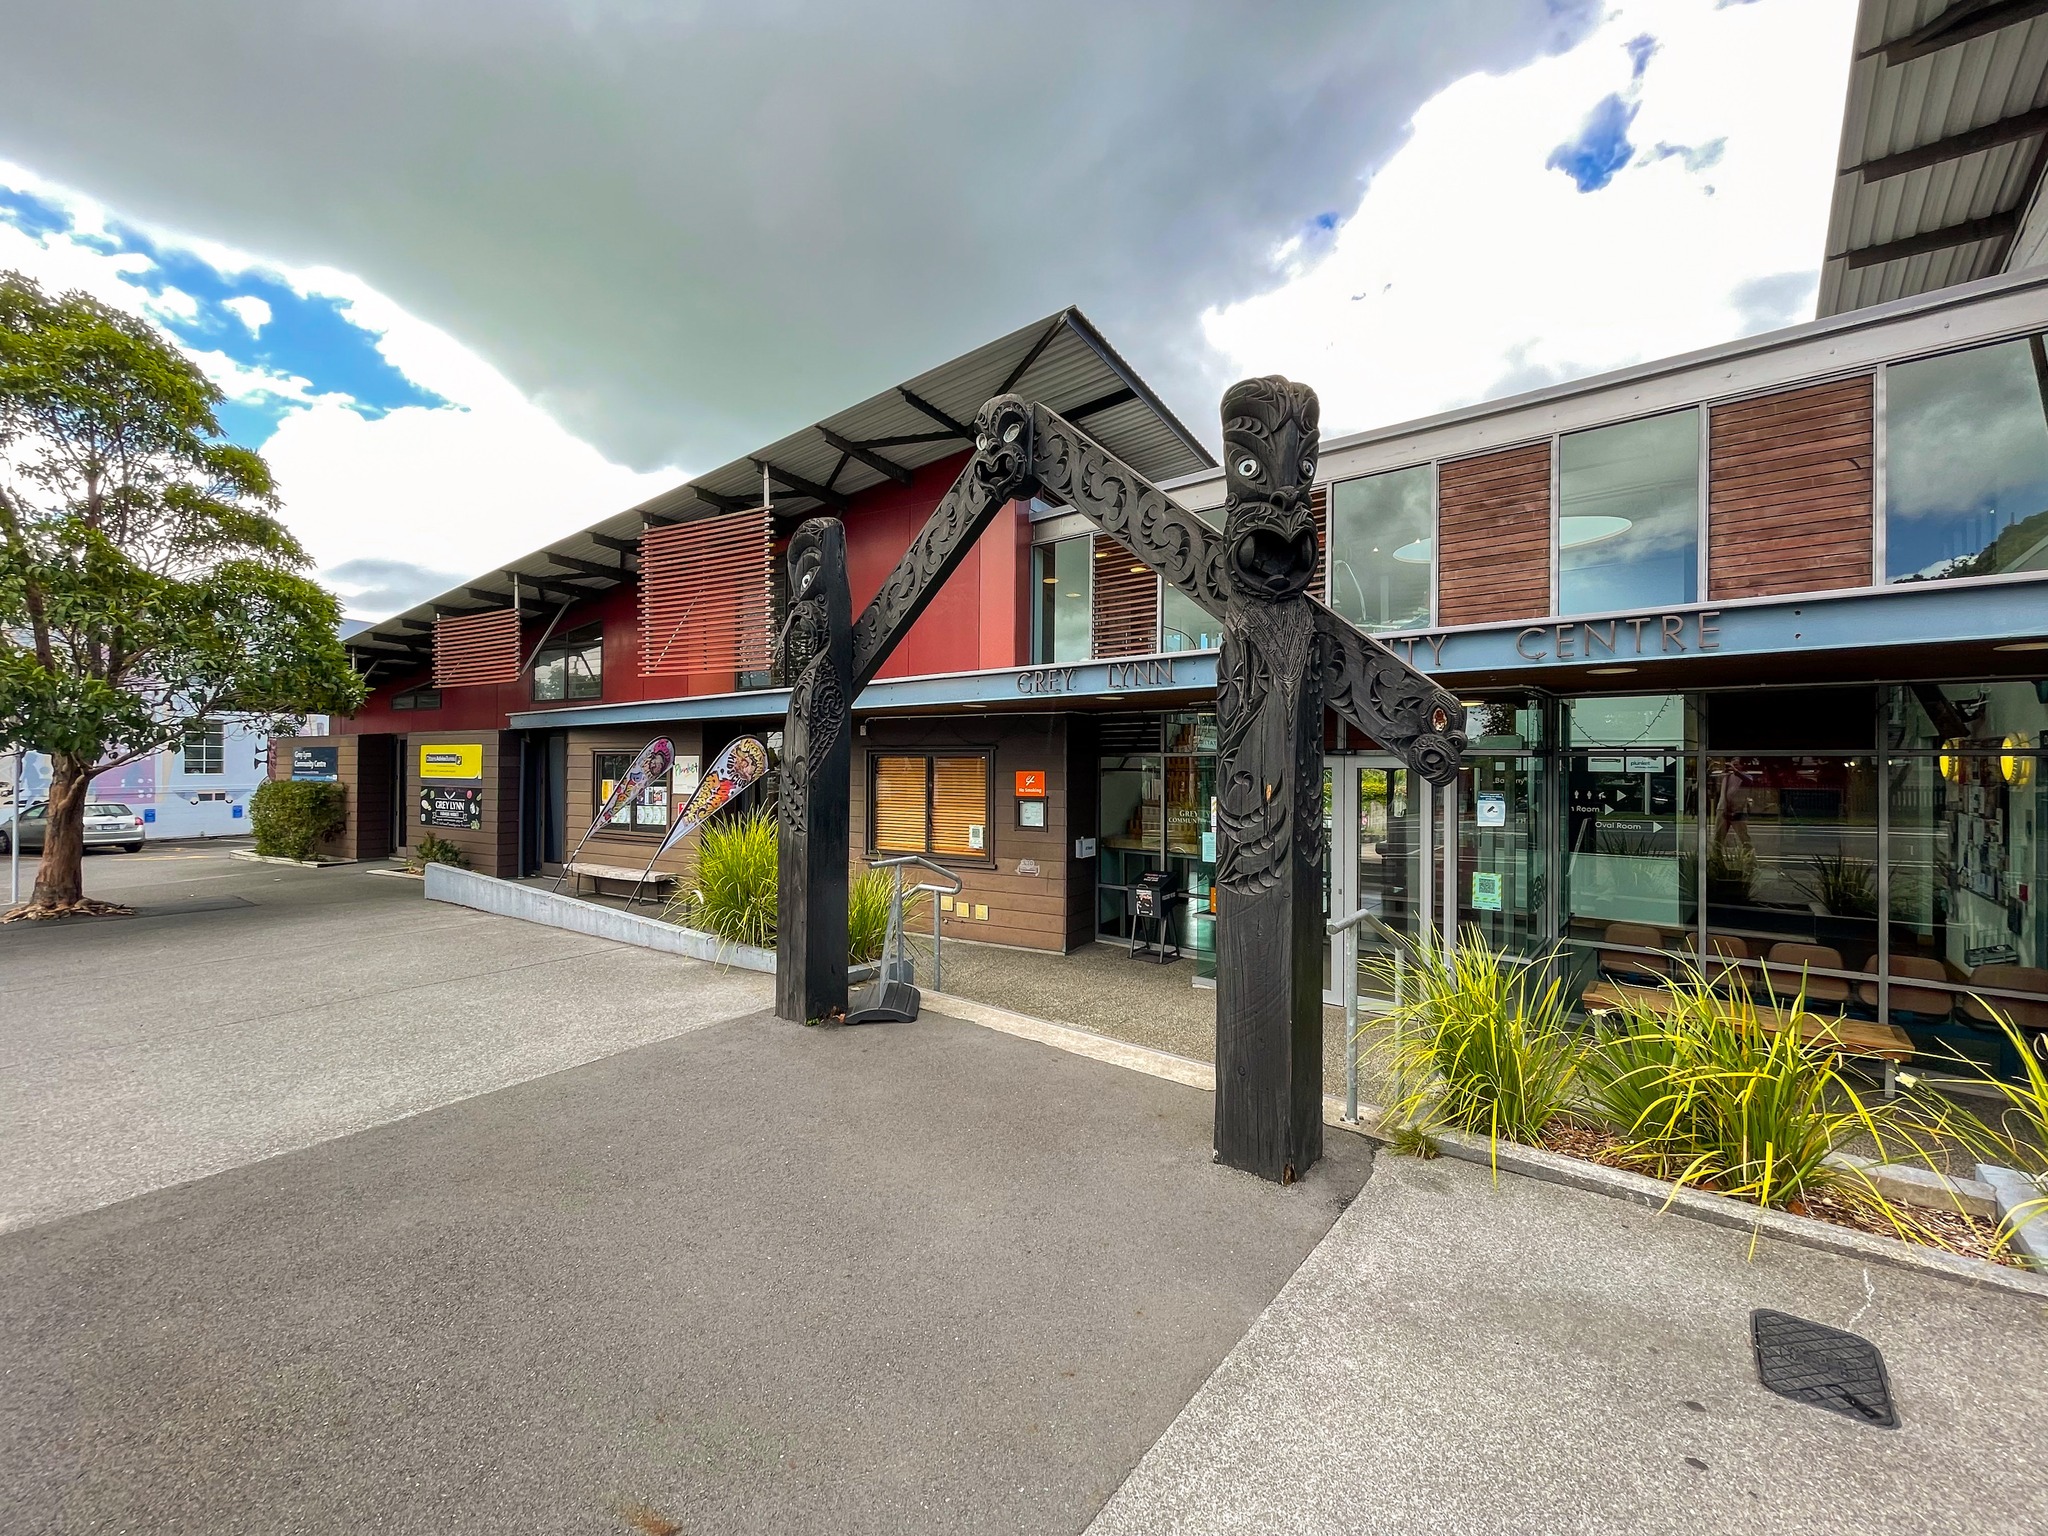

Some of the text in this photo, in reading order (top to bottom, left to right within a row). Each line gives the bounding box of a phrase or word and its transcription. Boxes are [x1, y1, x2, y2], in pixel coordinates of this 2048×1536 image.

[1516, 611, 1721, 660] CENTRE
[1016, 659, 1176, 694] GREY LYNN
[435, 800, 465, 811] GREY LYNN
[1616, 822, 1641, 830] Room
